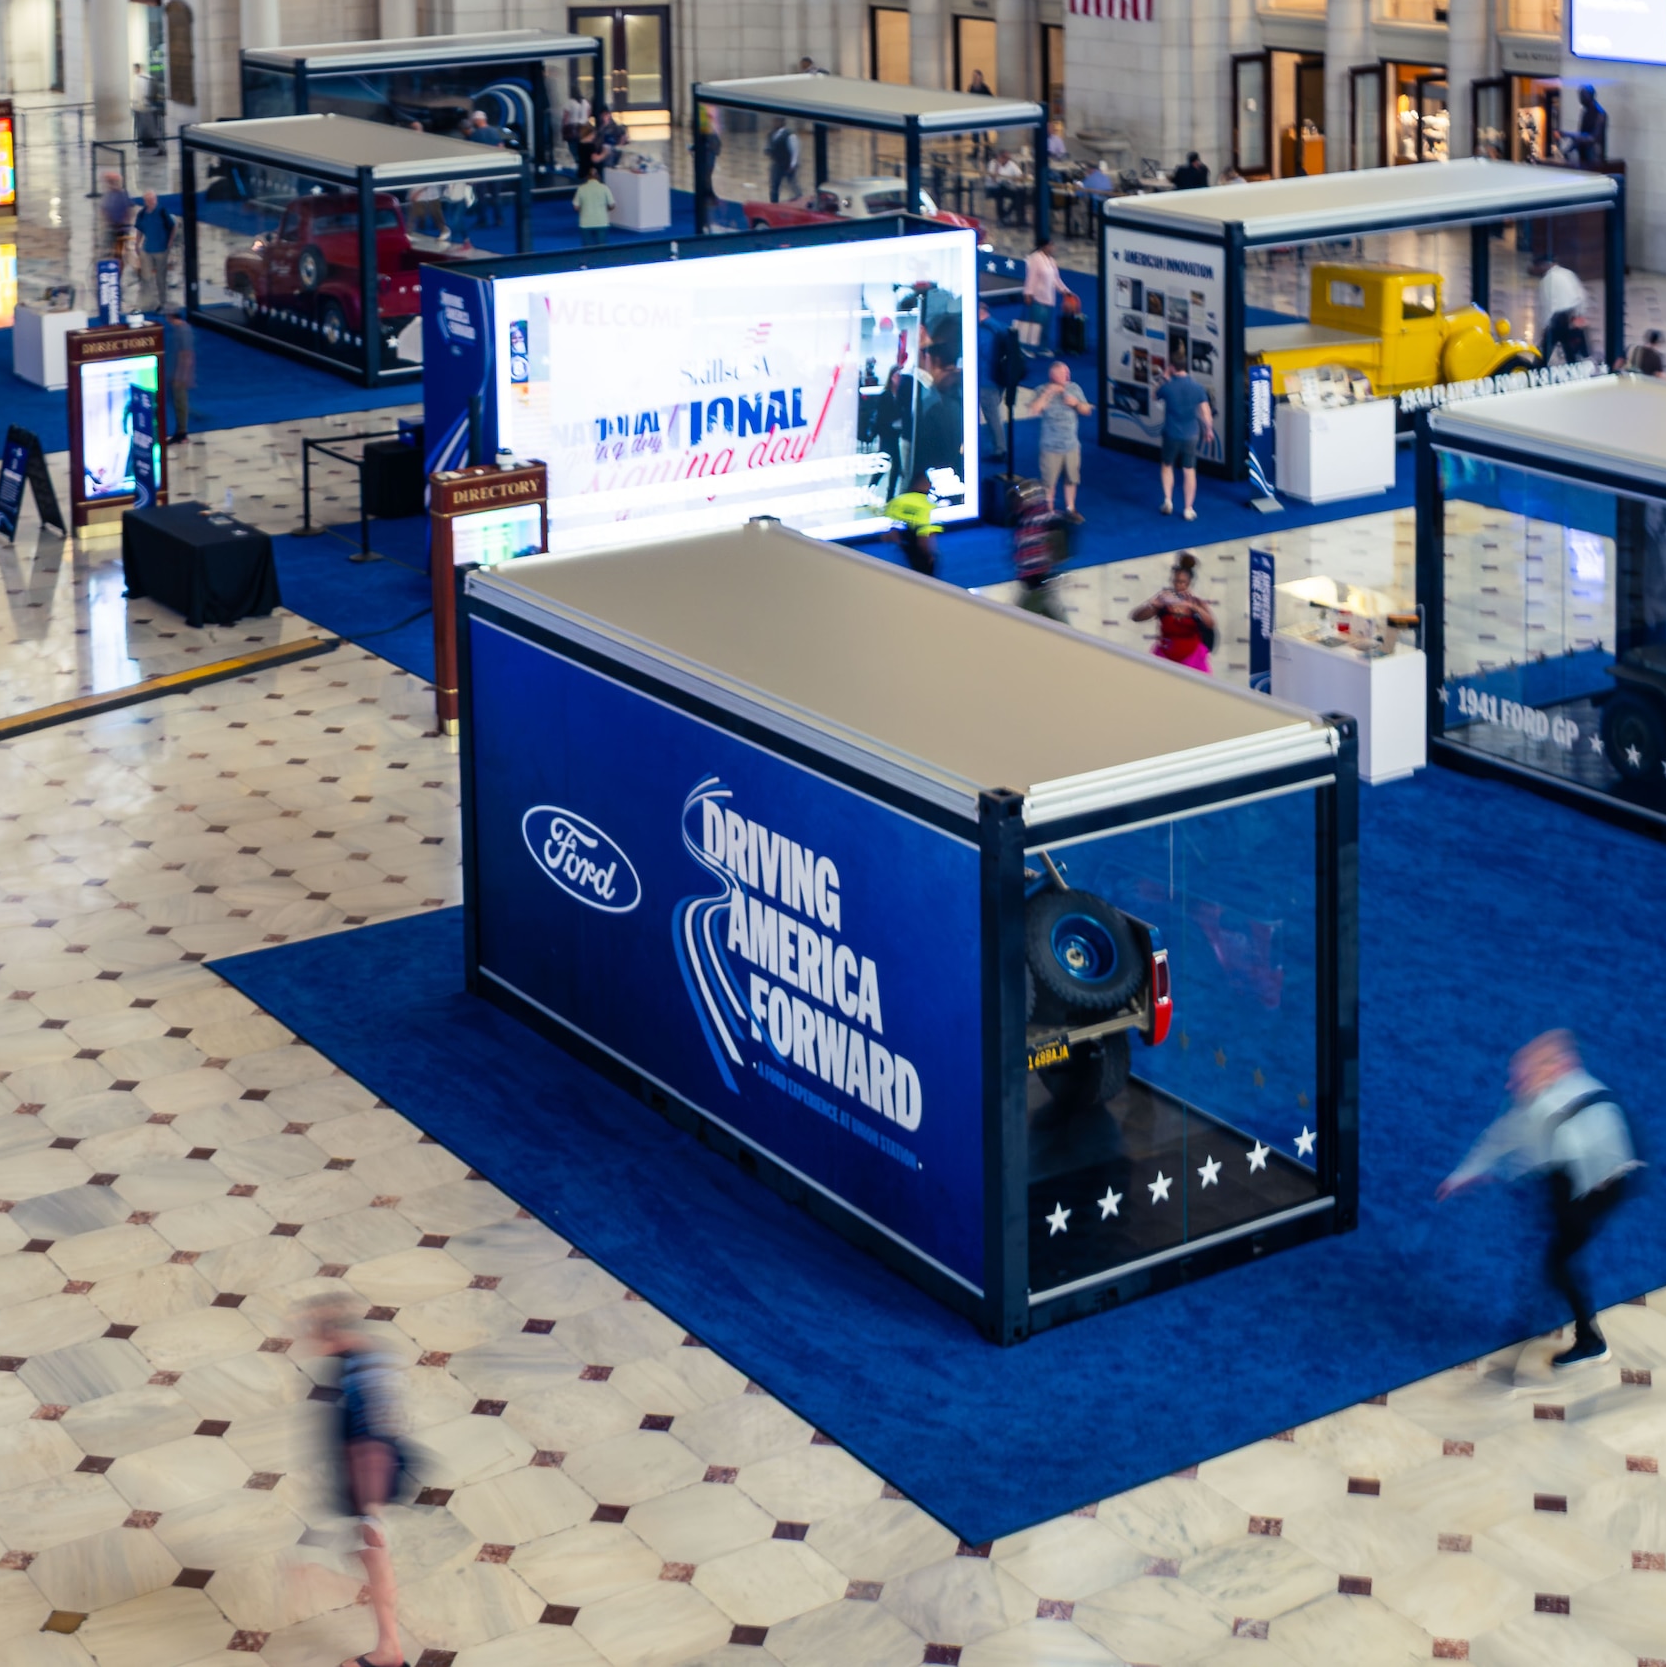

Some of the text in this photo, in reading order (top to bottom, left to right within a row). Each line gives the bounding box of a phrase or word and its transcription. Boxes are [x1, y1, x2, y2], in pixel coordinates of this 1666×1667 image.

[81, 336, 157, 354] DIRECTORY
[544, 296, 683, 330] WELCOME
[452, 478, 539, 505] DIRECTORY
[1457, 685, 1580, 751] 1941 FORD GP
[544, 816, 617, 902] Ford
[702, 796, 841, 933] DRIVING
[727, 887, 884, 1035] AMERICA
[749, 972, 924, 1133] FORWARD
[788, 1077, 839, 1124] EXPERIENCE
[880, 1133, 918, 1172] STATION
